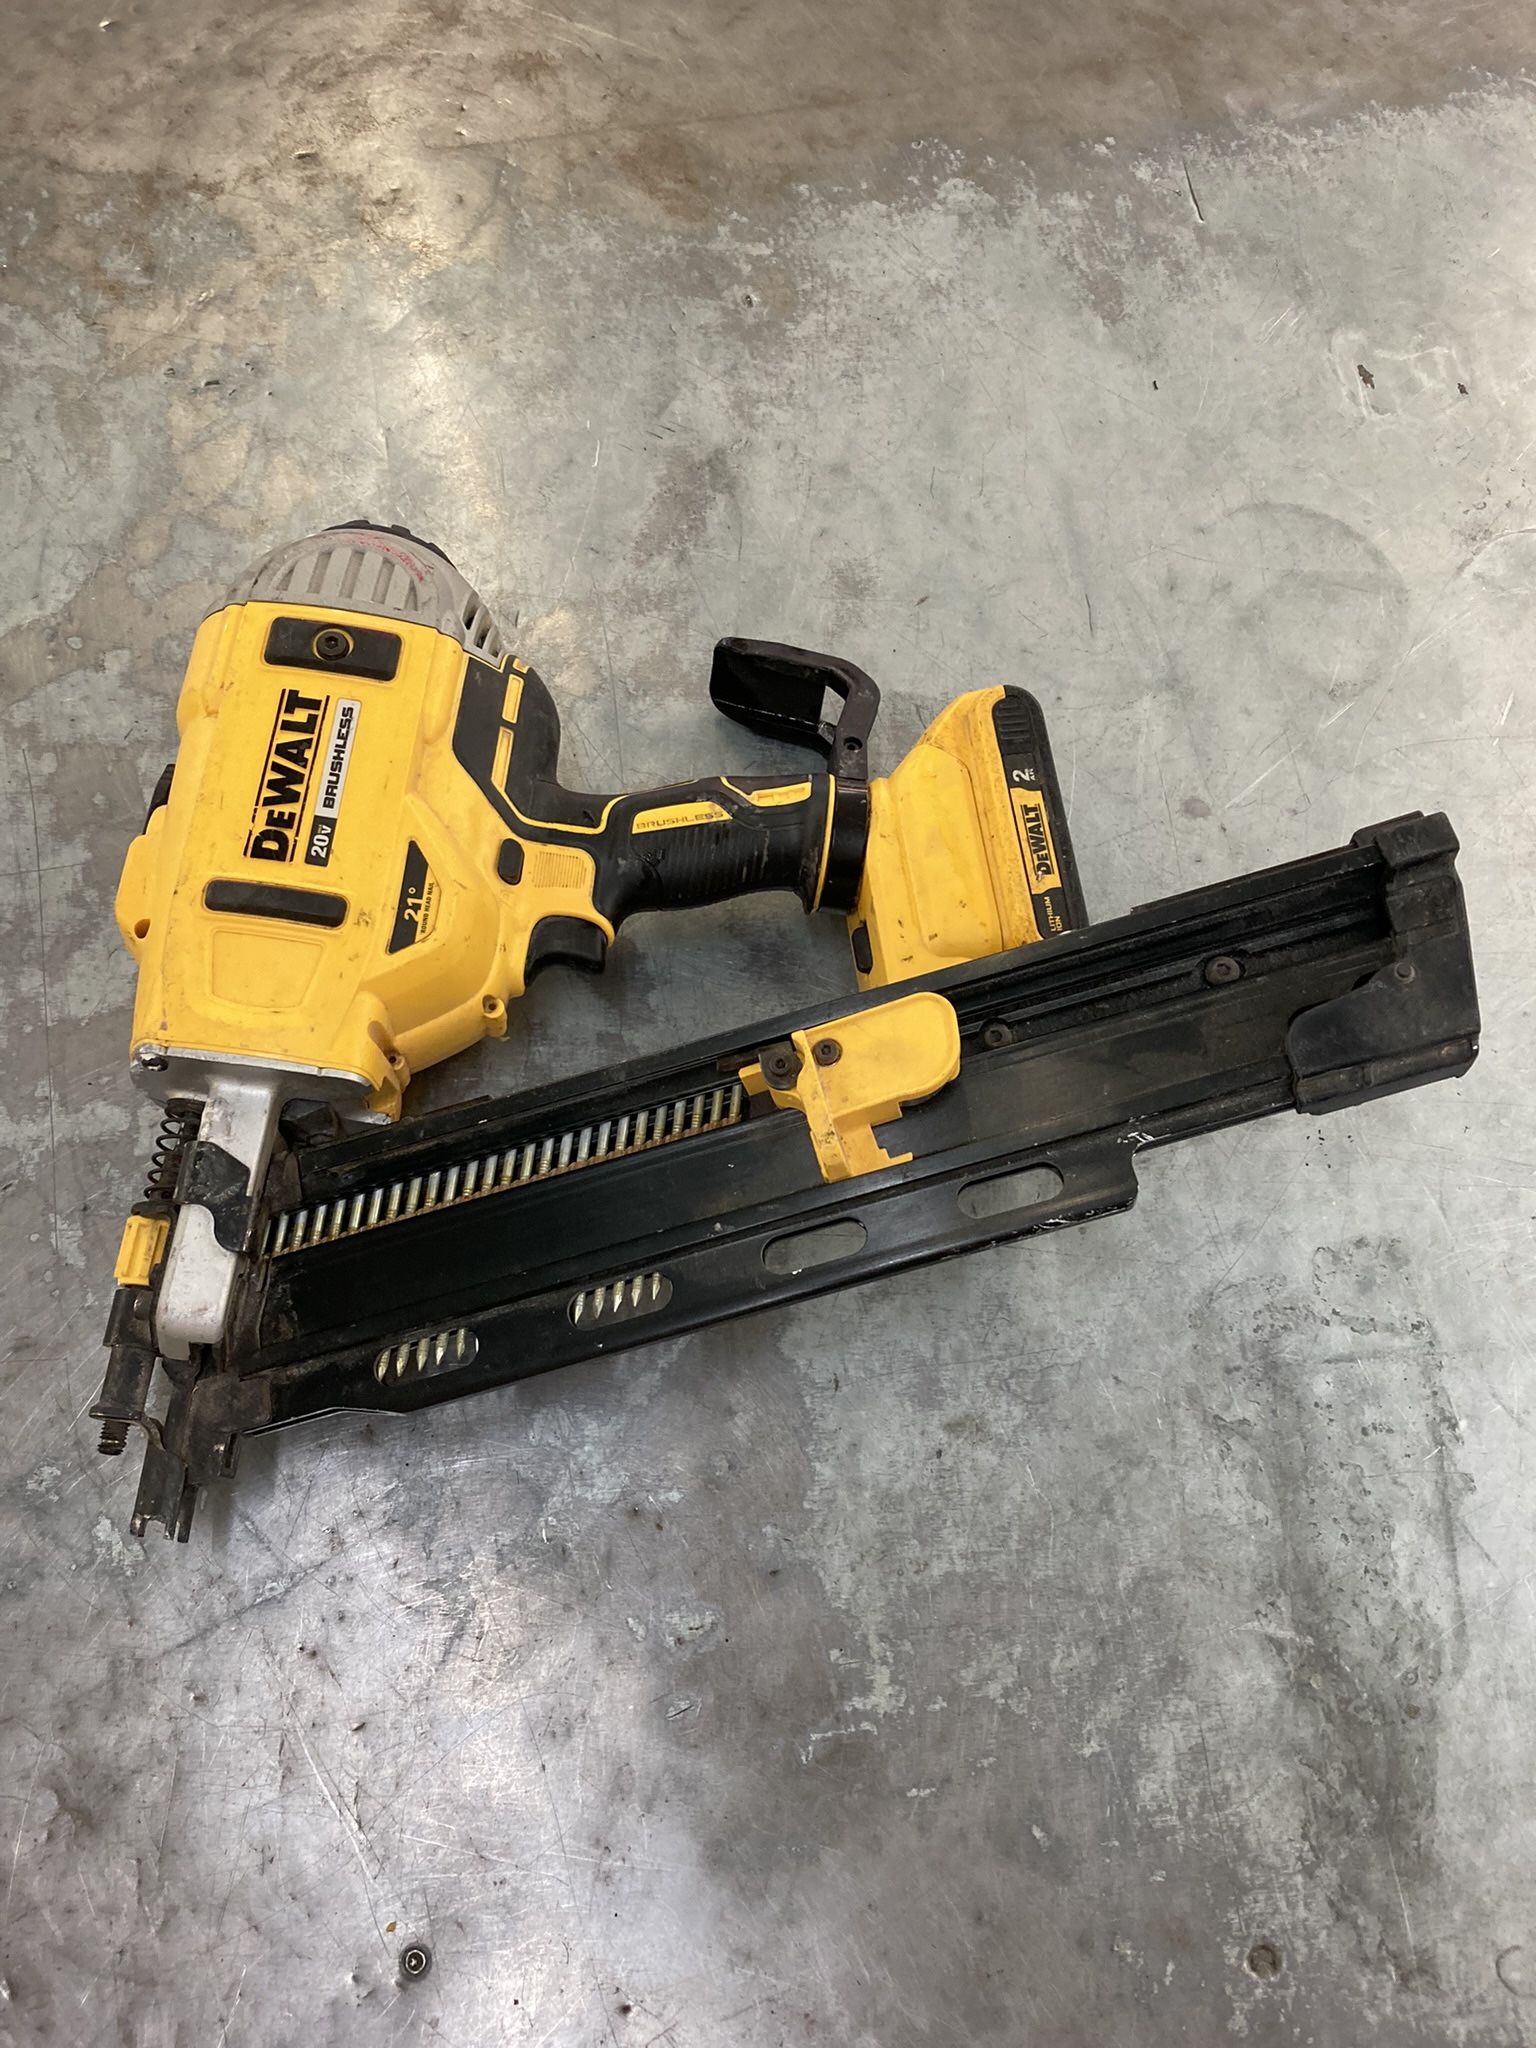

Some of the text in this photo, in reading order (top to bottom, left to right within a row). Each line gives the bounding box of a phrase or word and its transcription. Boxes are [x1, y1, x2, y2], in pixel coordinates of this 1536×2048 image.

[322, 706, 354, 809] BRUSHLESS
[1012, 768, 1030, 782] 2
[250, 689, 322, 862] DEWALT
[636, 811, 724, 830] BRUSHLESS
[1024, 804, 1051, 875] DEWALT
[404, 887, 423, 922] 21°
[1043, 896, 1057, 932] LITHIUM
[1054, 915, 1063, 931] ION
